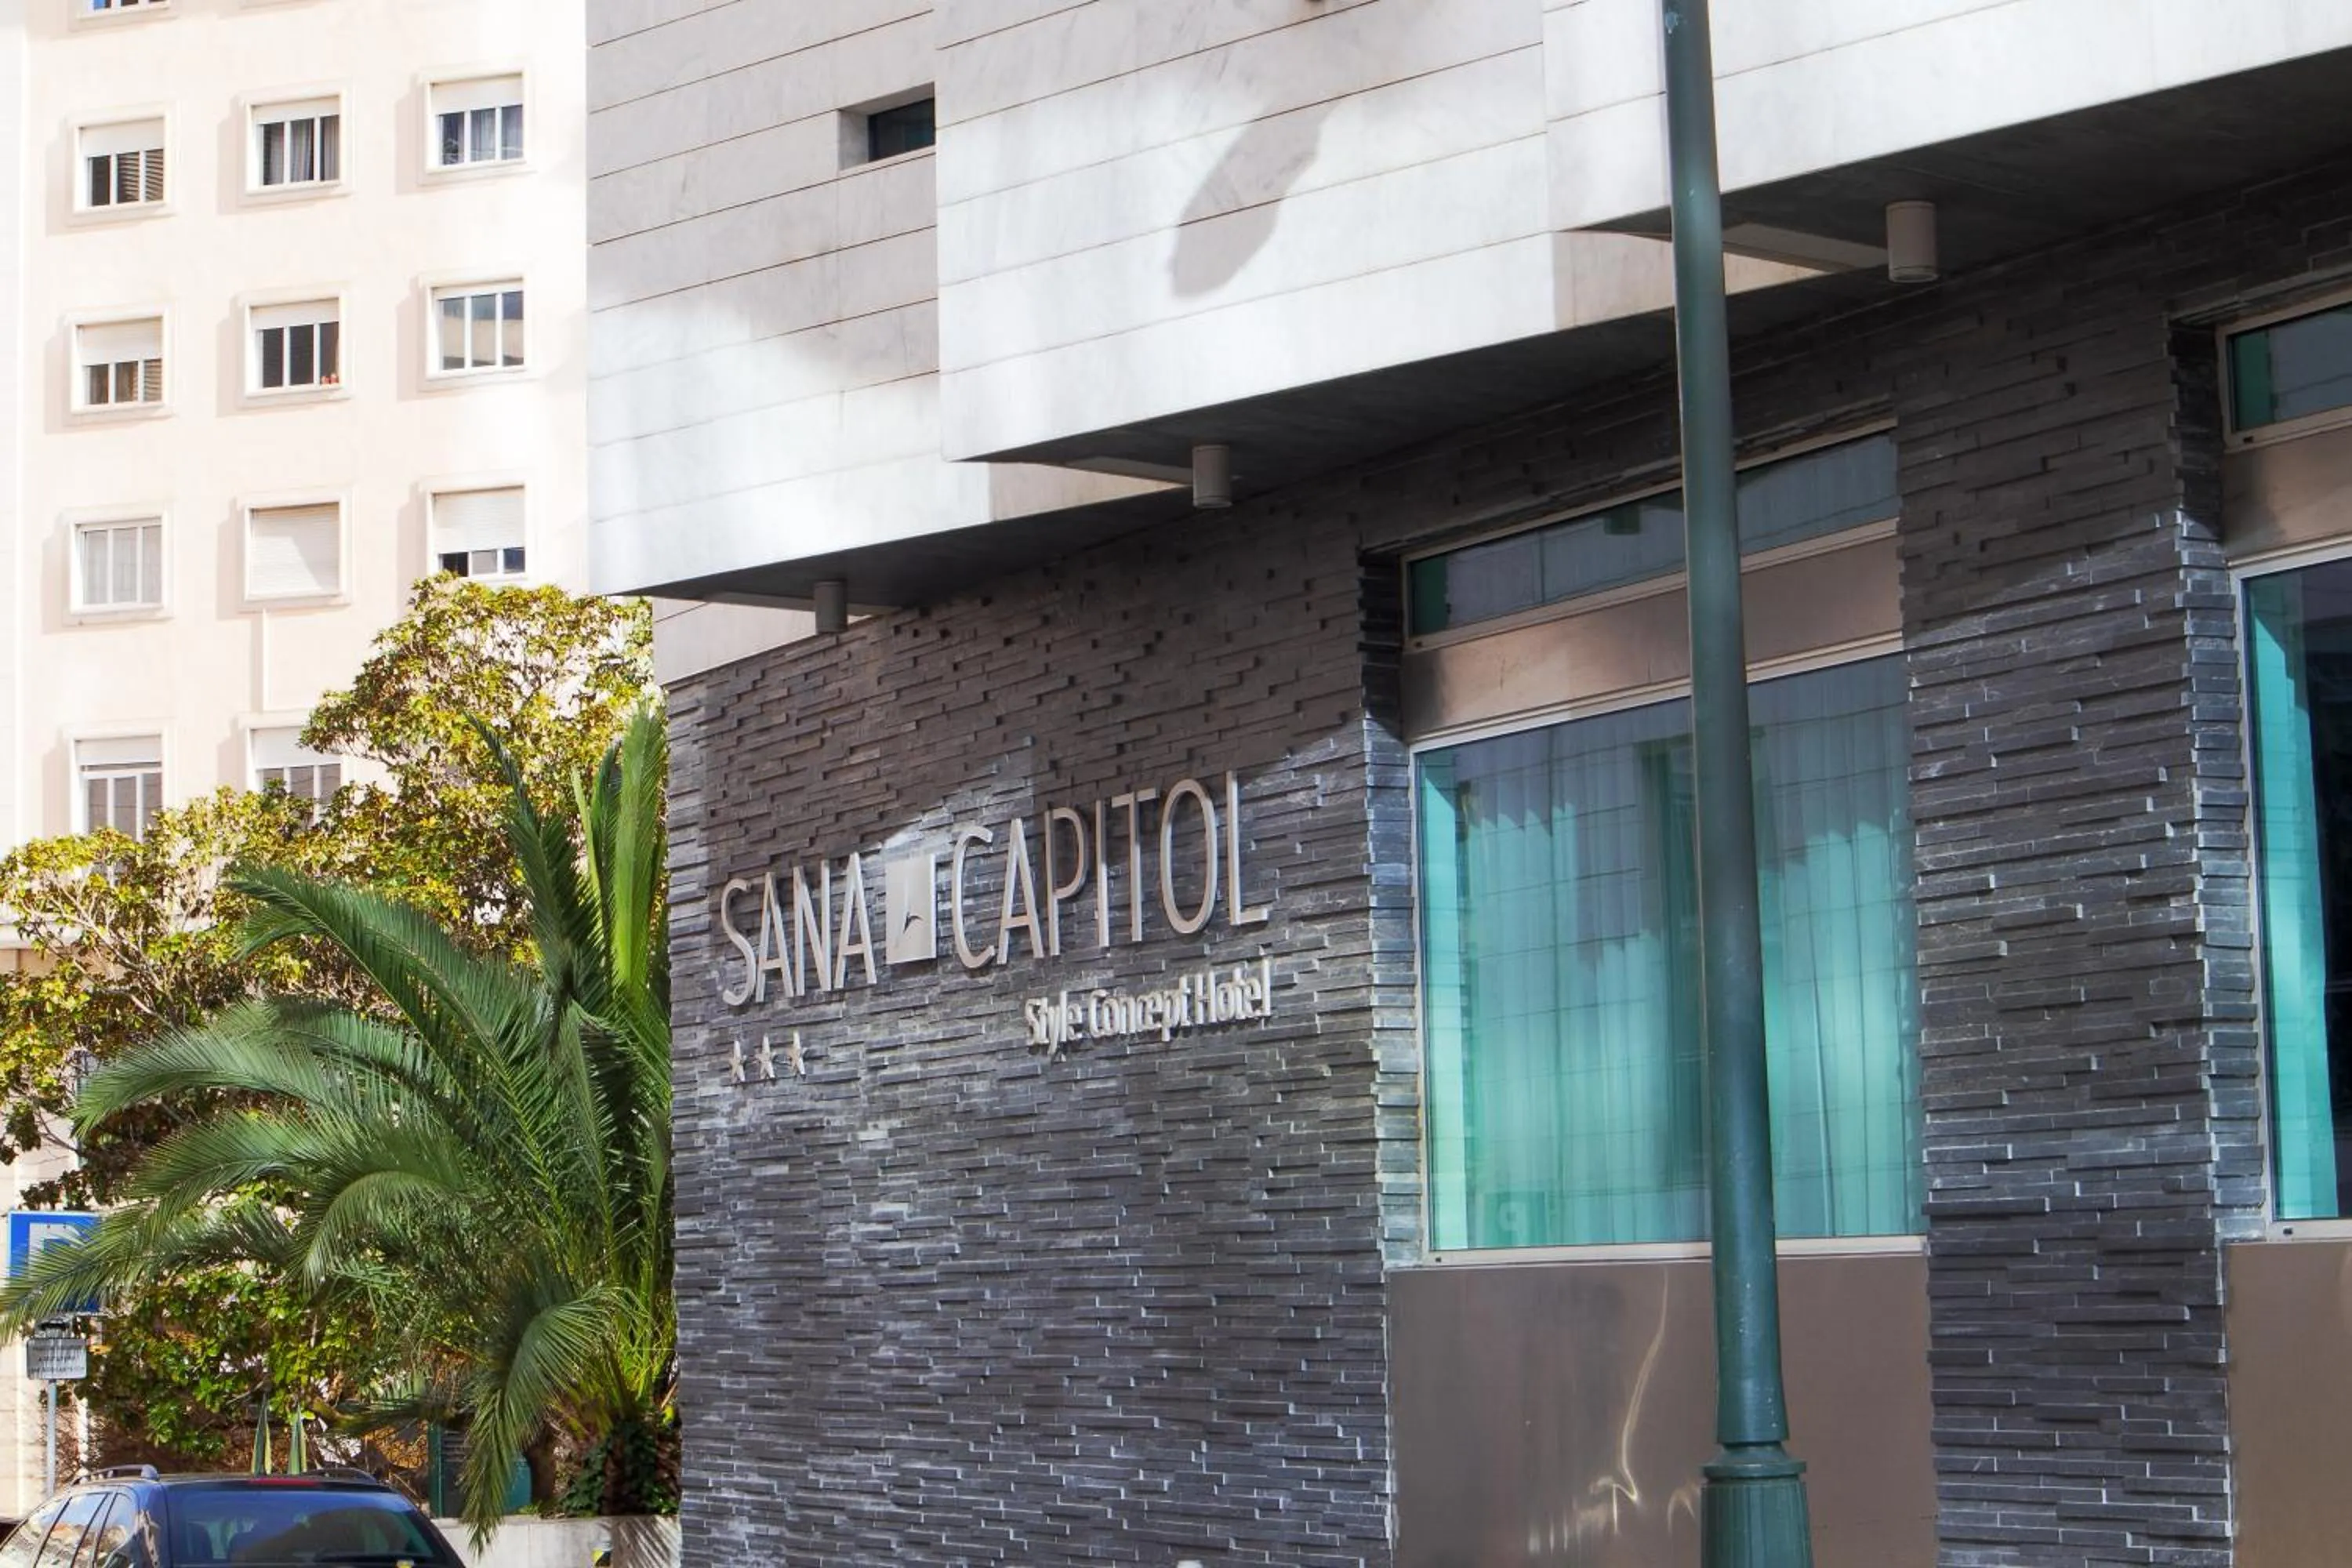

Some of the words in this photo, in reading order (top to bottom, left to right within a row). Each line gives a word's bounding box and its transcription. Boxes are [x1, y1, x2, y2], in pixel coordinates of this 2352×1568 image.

[721, 851, 877, 1005] SANA
[951, 770, 1269, 969] CAPITOL
[1025, 990, 1082, 1054] Style
[1088, 981, 1191, 1041] Concept
[1194, 957, 1271, 1025] Hotel
